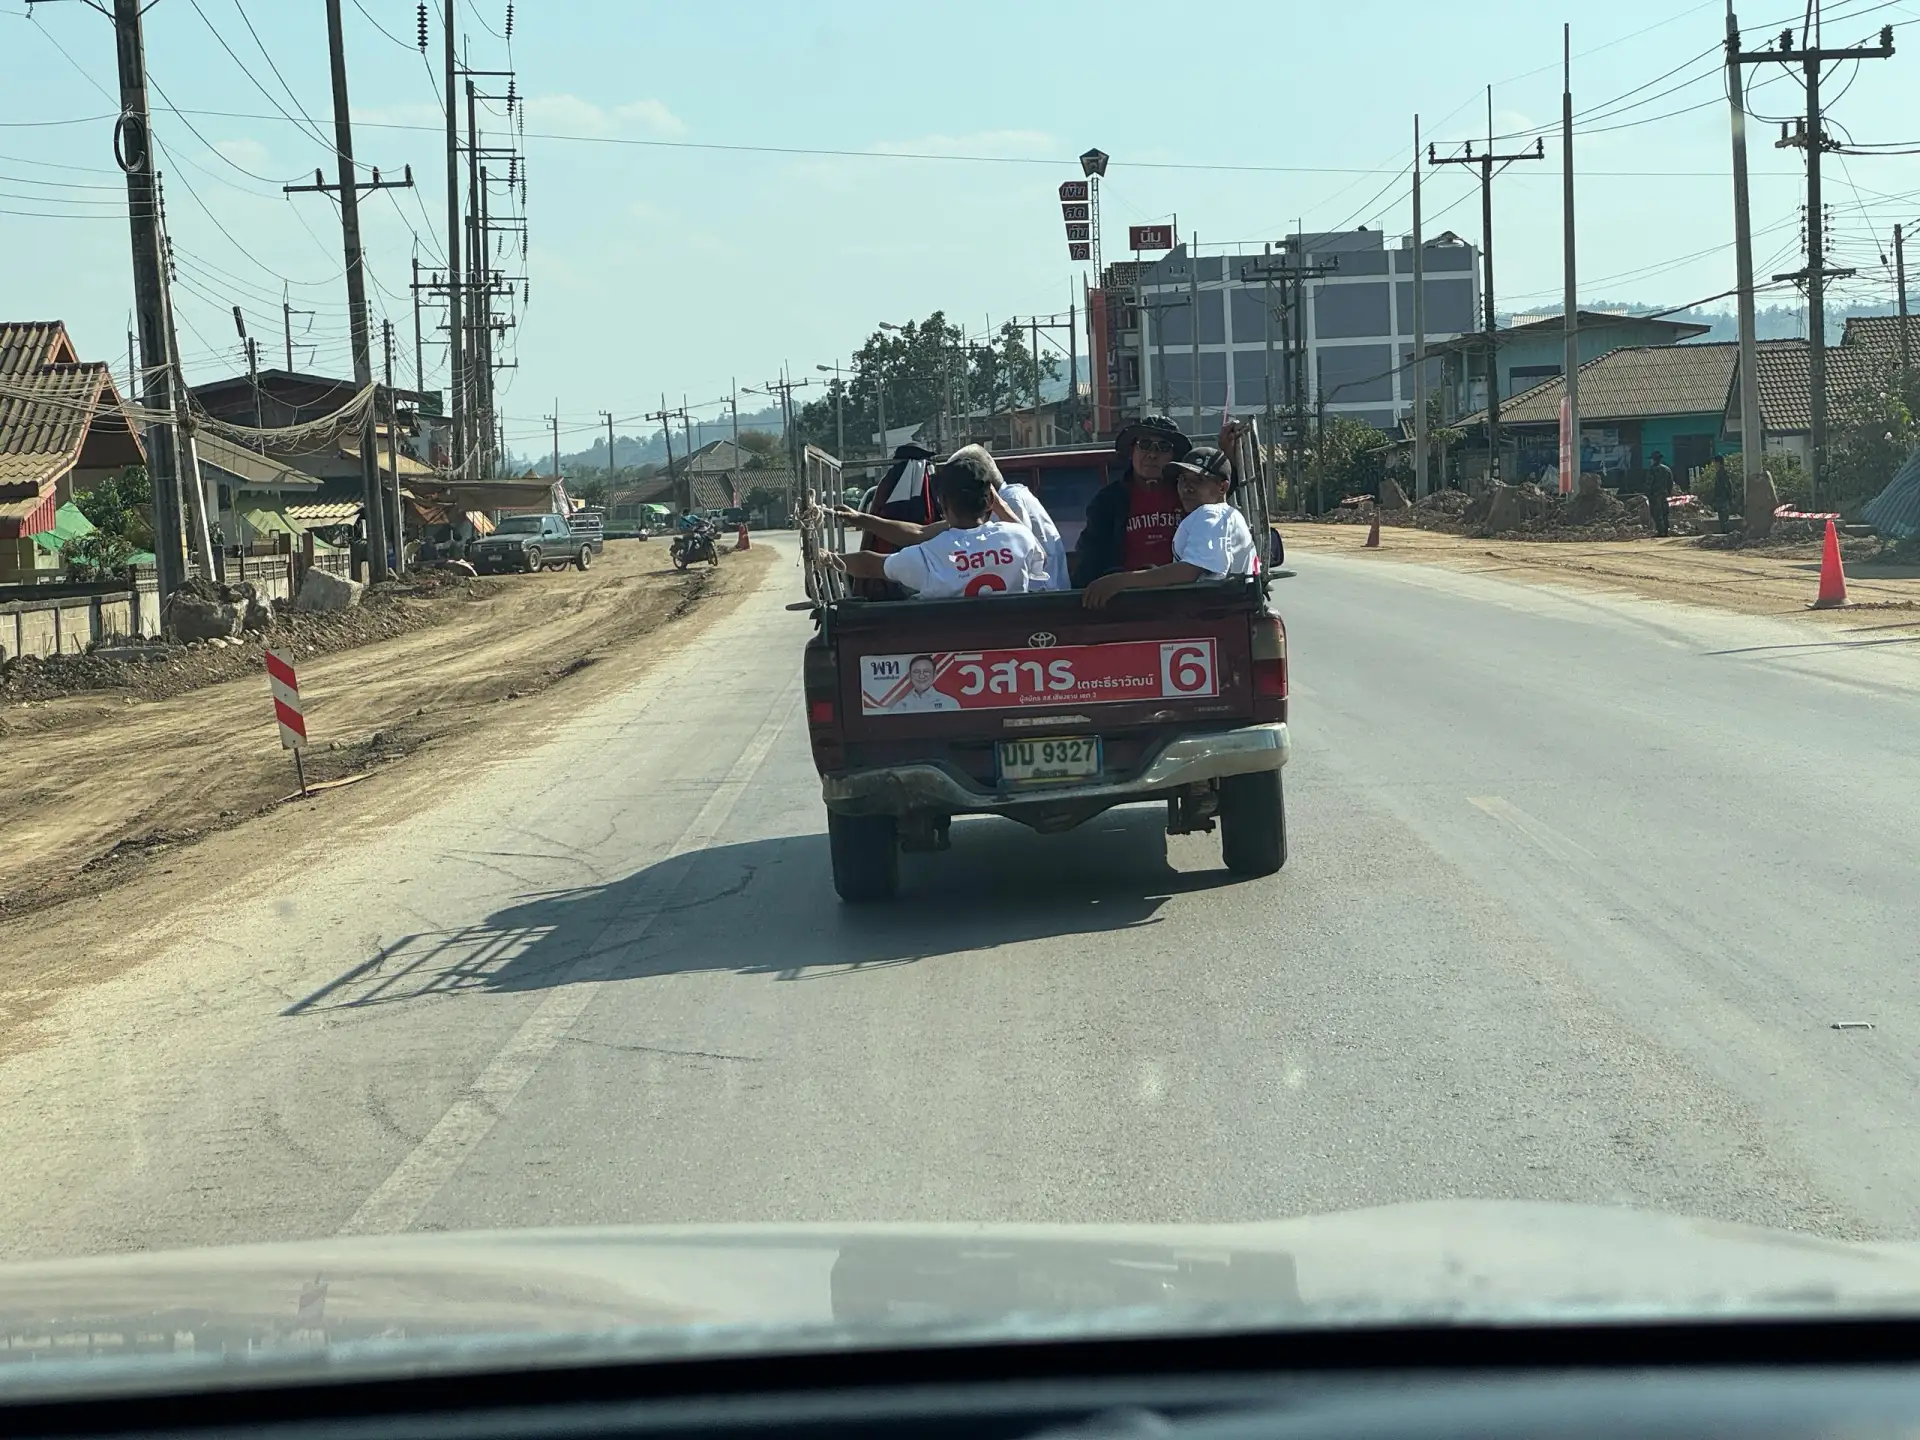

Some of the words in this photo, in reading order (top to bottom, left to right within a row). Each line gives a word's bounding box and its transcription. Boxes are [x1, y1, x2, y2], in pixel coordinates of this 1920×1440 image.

[1062, 183, 1085, 198] เงิน
[1065, 206, 1085, 218] สด
[1073, 245, 1087, 259] ใจ
[954, 548, 1013, 571] วิสาร
[870, 661, 899, 675] พท
[954, 654, 1075, 695] วิสาร
[1077, 674, 1154, 690] เตชะธีราวัฒน์
[1169, 647, 1206, 692] 6
[1043, 740, 1094, 763] 9327
